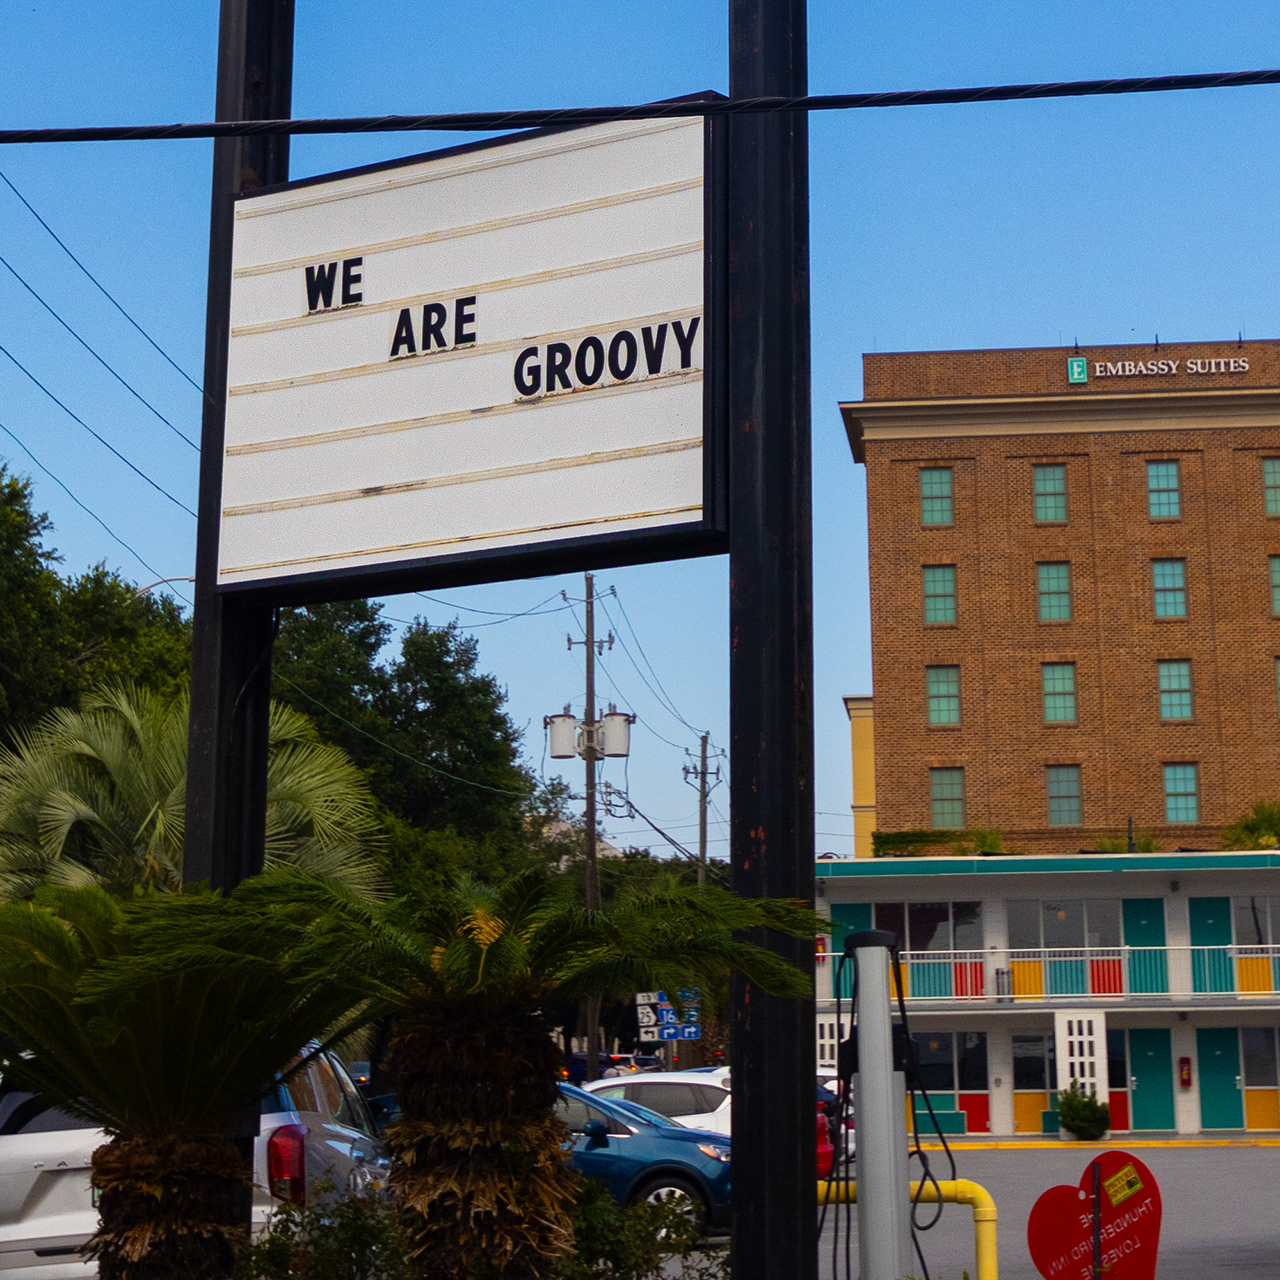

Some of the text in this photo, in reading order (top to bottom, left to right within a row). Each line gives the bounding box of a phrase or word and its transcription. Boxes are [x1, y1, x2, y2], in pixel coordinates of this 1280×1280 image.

[305, 257, 363, 311] WE
[390, 295, 476, 357] ARE
[514, 316, 701, 396] GROOVY
[1095, 358, 1250, 376] EMBASSY SUITES
[662, 1010, 677, 1023] 16
